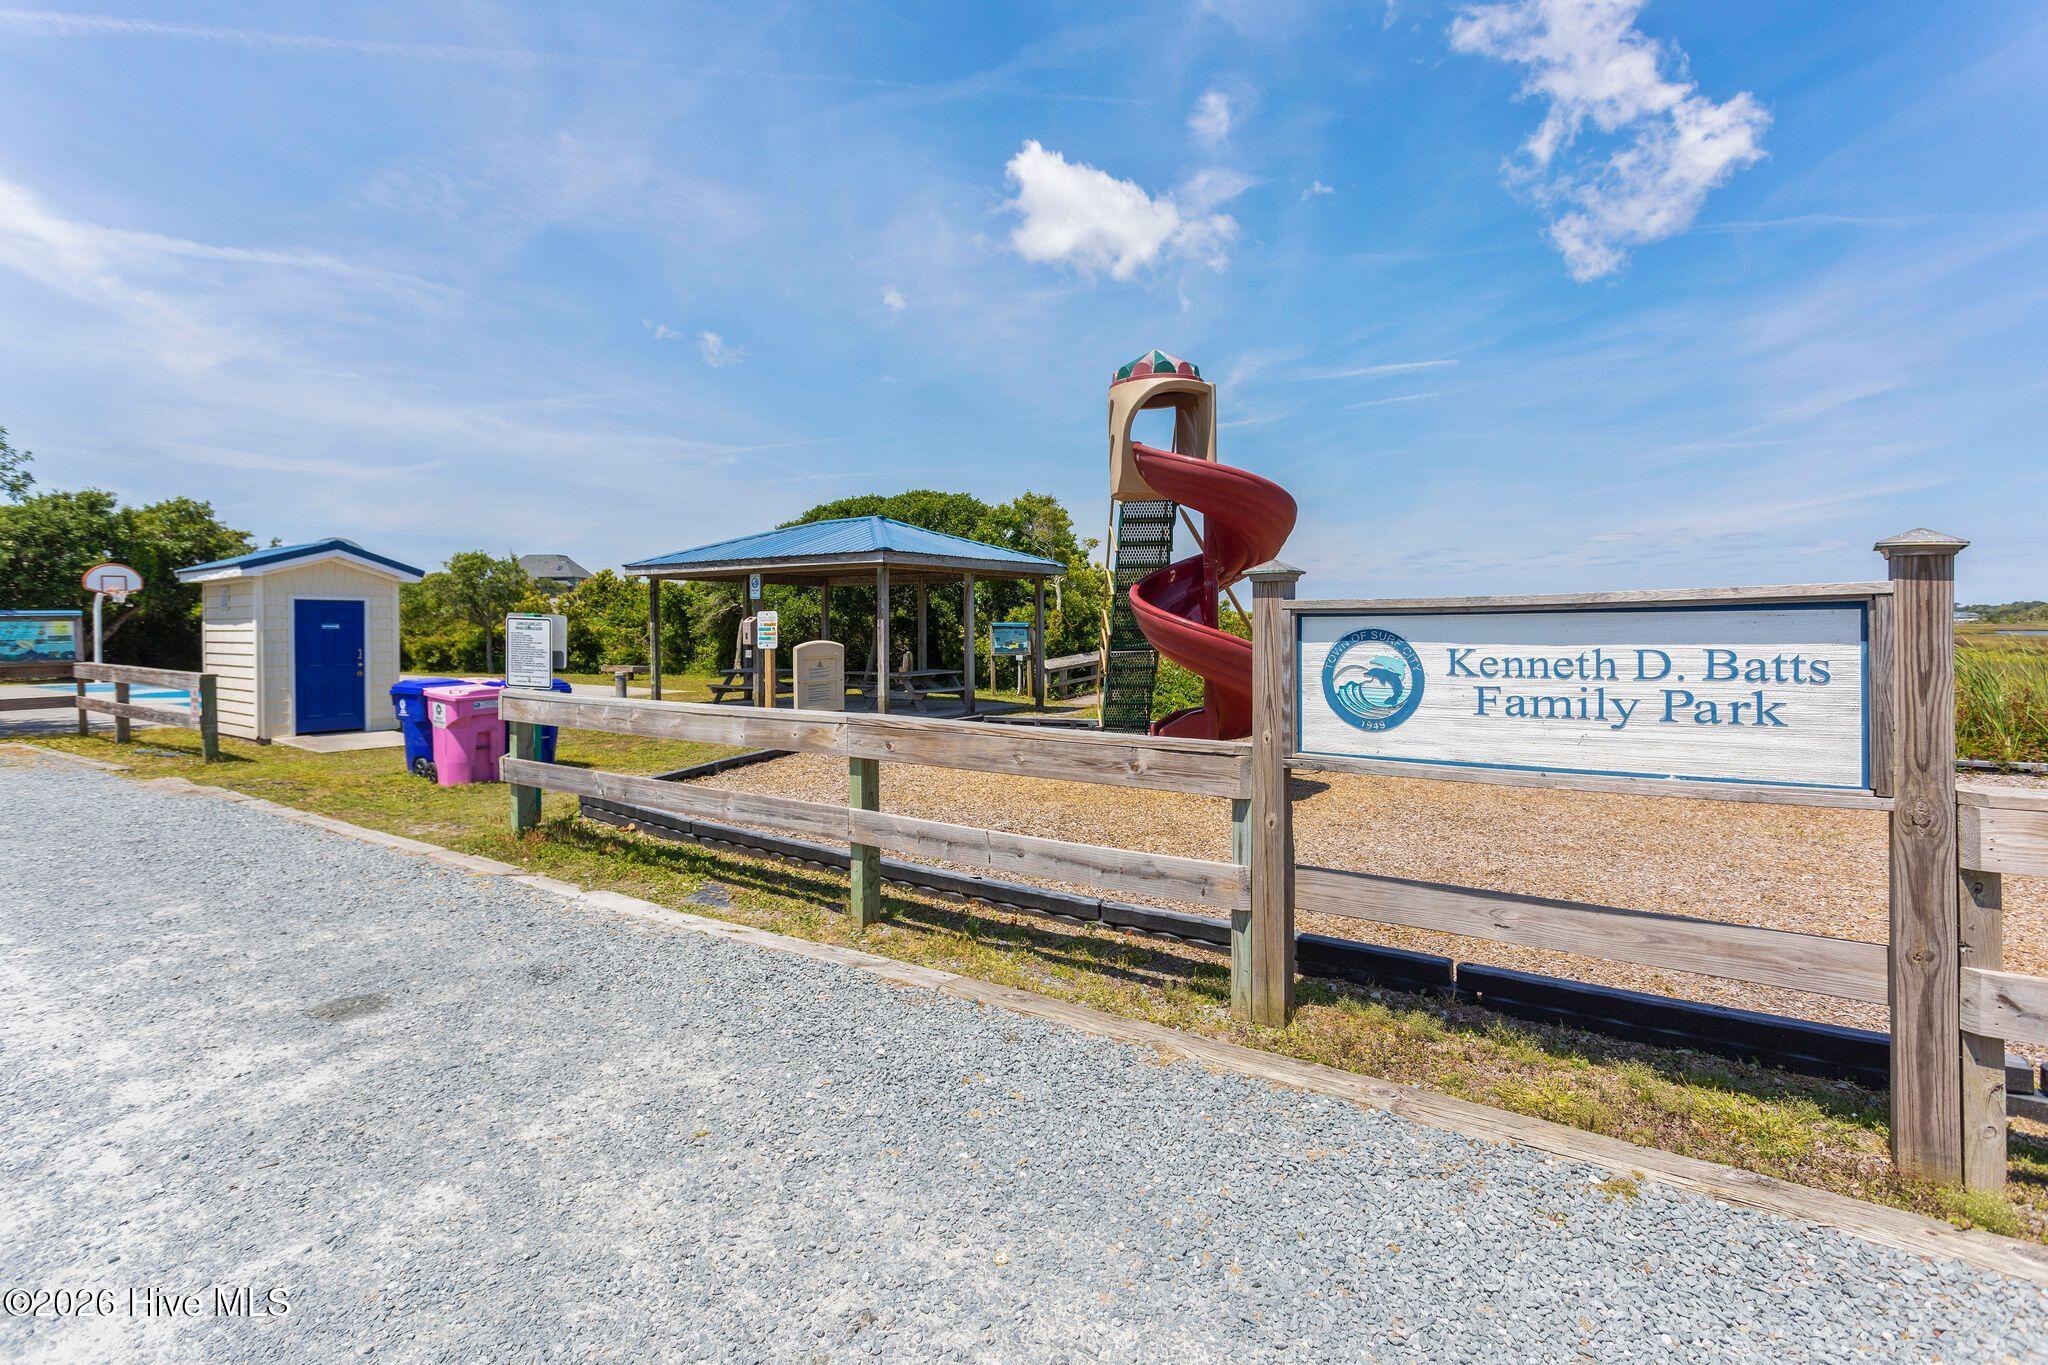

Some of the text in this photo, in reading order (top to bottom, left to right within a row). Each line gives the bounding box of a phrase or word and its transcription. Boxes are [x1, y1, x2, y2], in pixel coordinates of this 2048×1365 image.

[1325, 630, 1422, 671] TOWN OF SURF CITY
[1446, 648, 1831, 686] Kenneth D. Batts
[1361, 719, 1386, 730] 1949
[1473, 685, 1789, 730] Family Park
